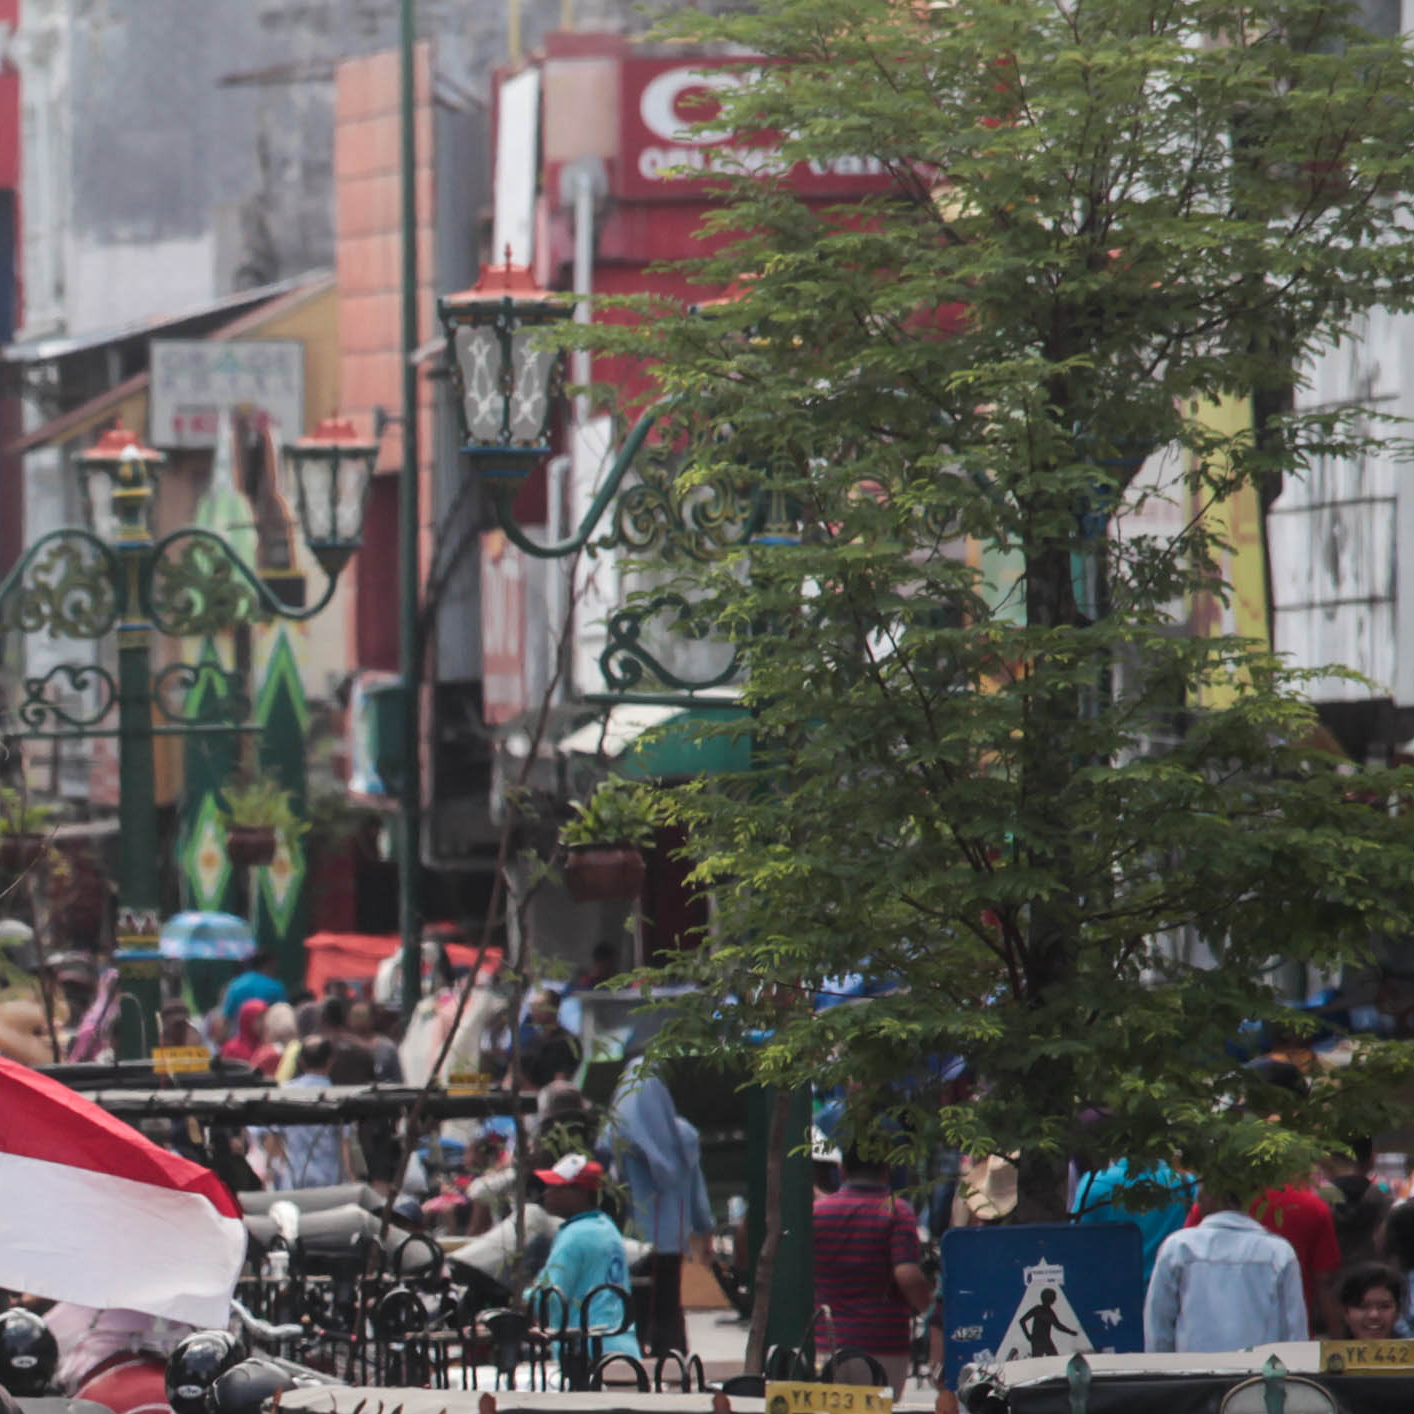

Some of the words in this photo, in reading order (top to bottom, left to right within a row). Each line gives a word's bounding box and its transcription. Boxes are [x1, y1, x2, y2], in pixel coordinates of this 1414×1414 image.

[1345, 1346, 1367, 1363] YK
[1373, 1346, 1410, 1364] 442
[791, 1389, 813, 1407] YK
[820, 1390, 854, 1410] 133
